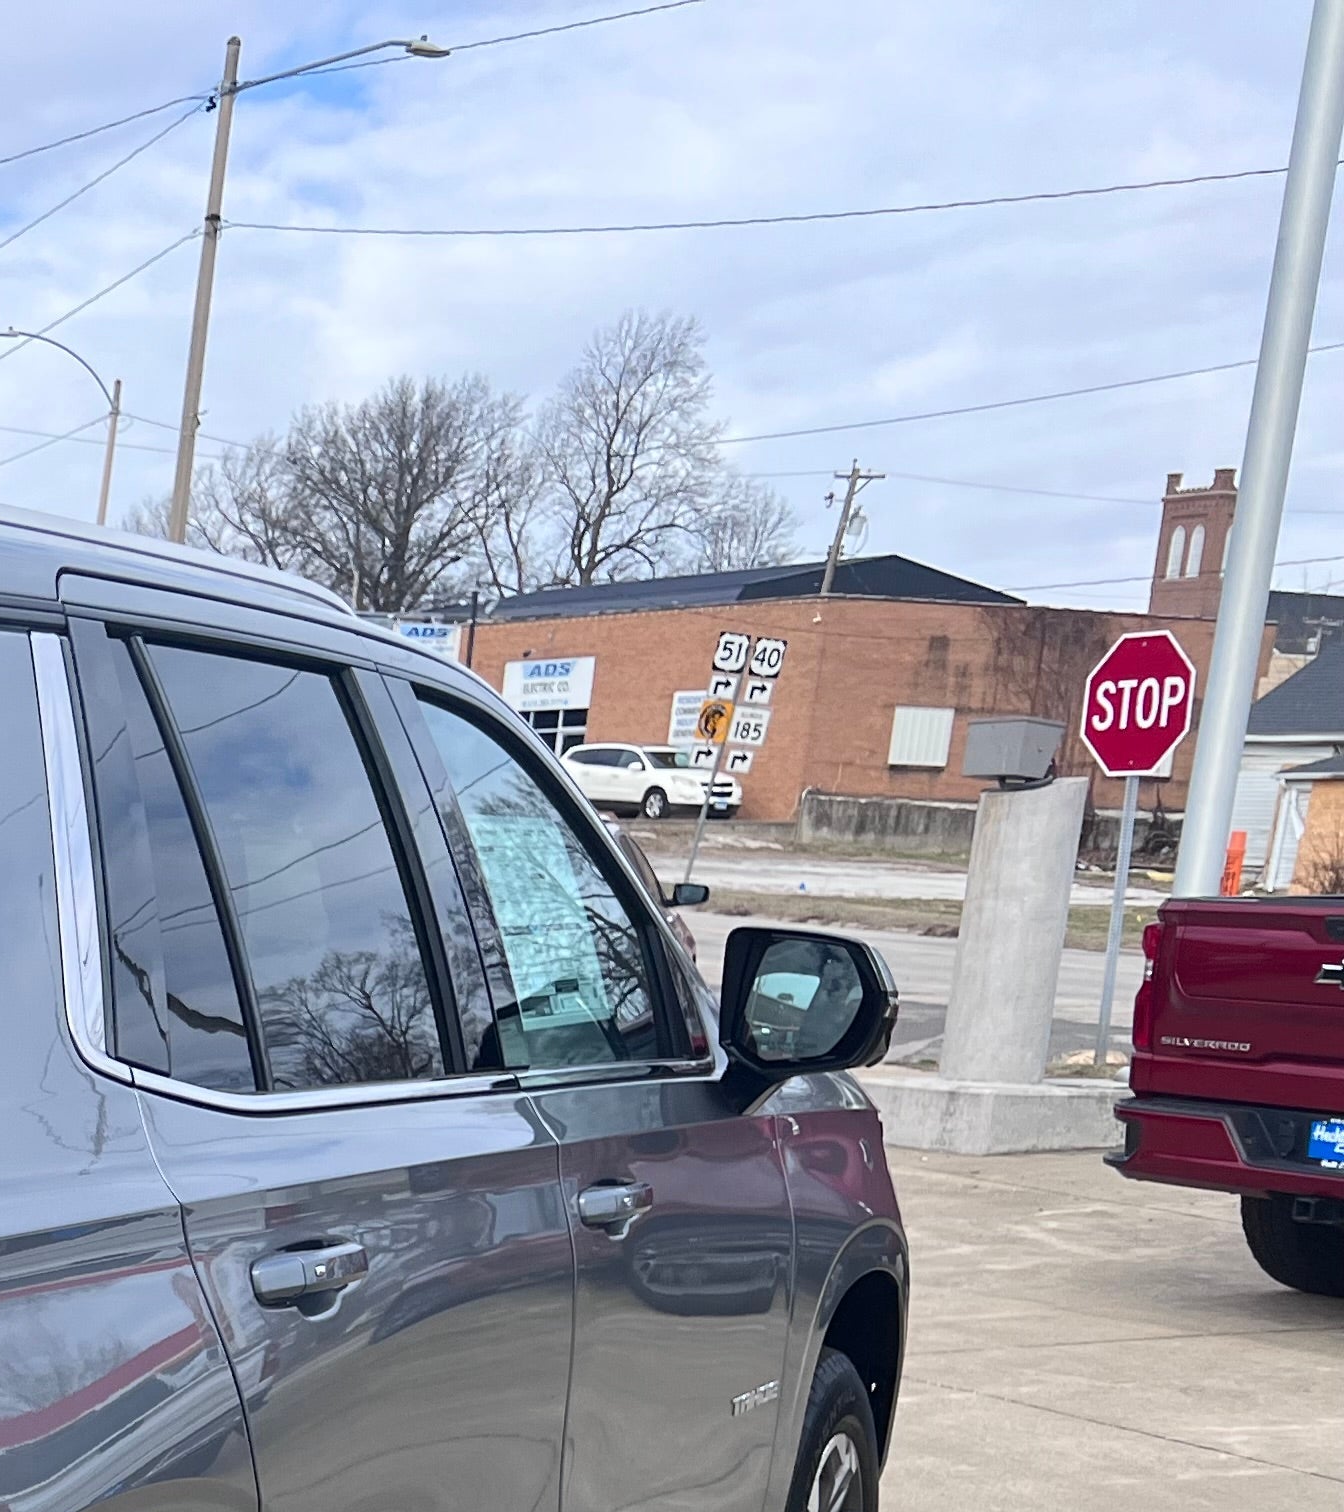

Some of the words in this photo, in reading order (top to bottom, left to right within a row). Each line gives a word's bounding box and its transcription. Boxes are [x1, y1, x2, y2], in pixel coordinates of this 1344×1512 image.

[407, 626, 448, 637] ADS
[720, 641, 743, 663] 51
[754, 647, 781, 668] 40
[528, 662, 572, 677] ADS
[1092, 676, 1185, 731] STOP
[734, 721, 763, 740] 185
[1161, 1036, 1251, 1052] SILVERADO
